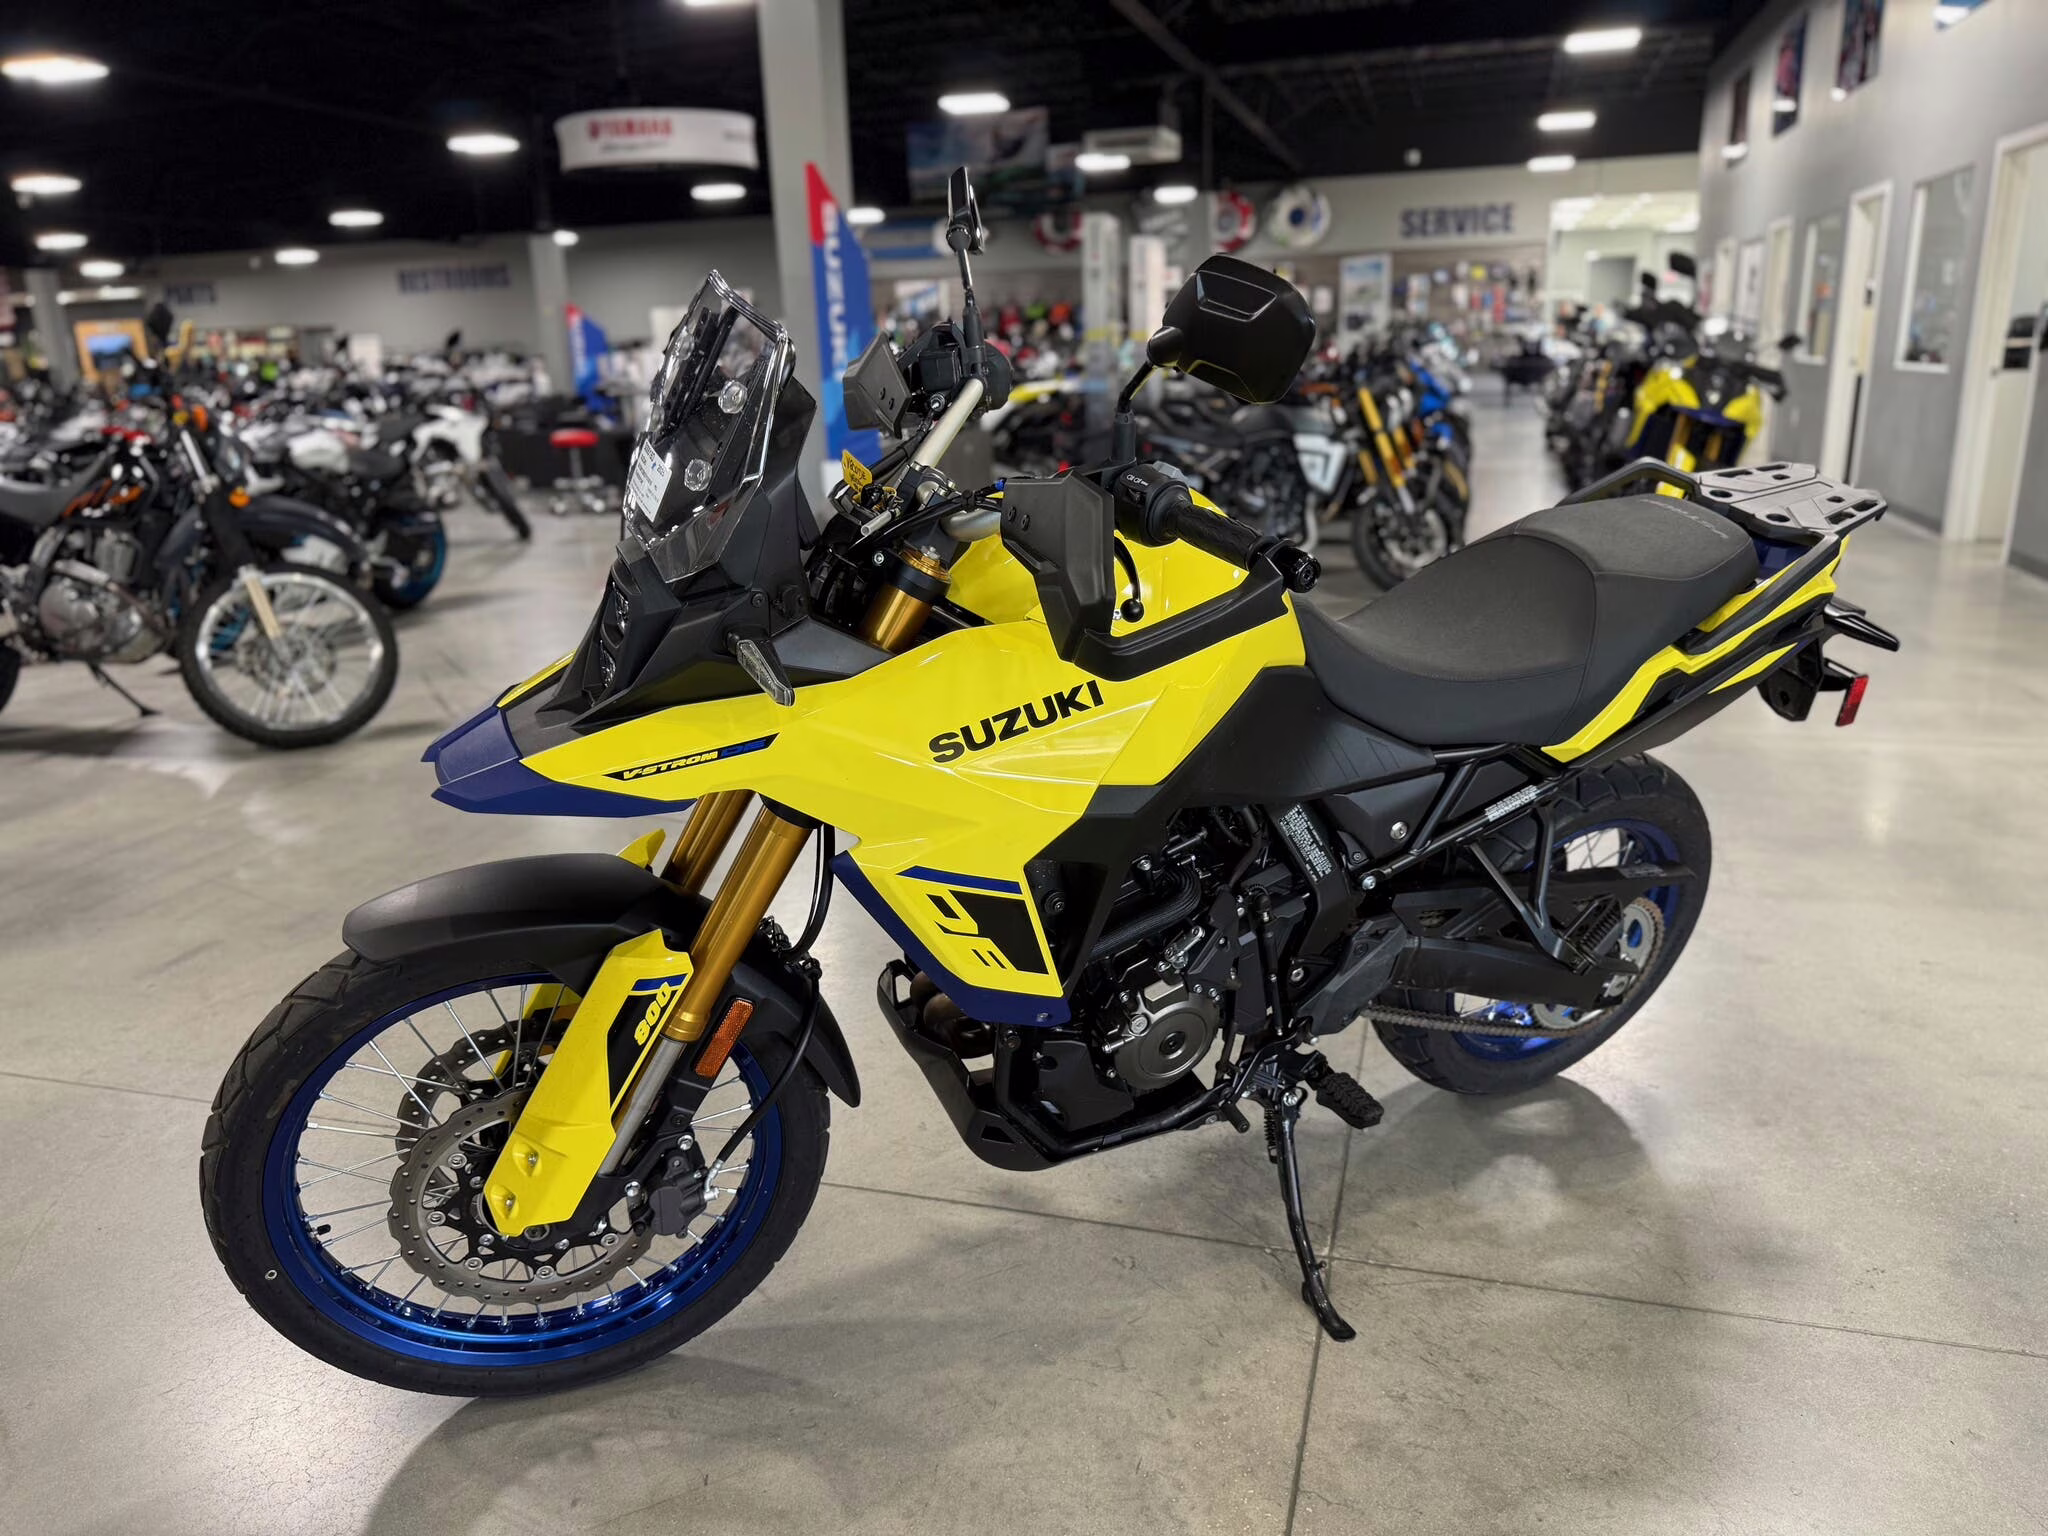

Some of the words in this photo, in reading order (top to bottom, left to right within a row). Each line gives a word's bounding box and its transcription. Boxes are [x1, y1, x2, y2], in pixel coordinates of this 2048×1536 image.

[1400, 203, 1515, 237] SERVICE
[928, 680, 1105, 763] SUZUKI
[623, 751, 718, 779] V-STROM
[634, 981, 672, 1046] 800
